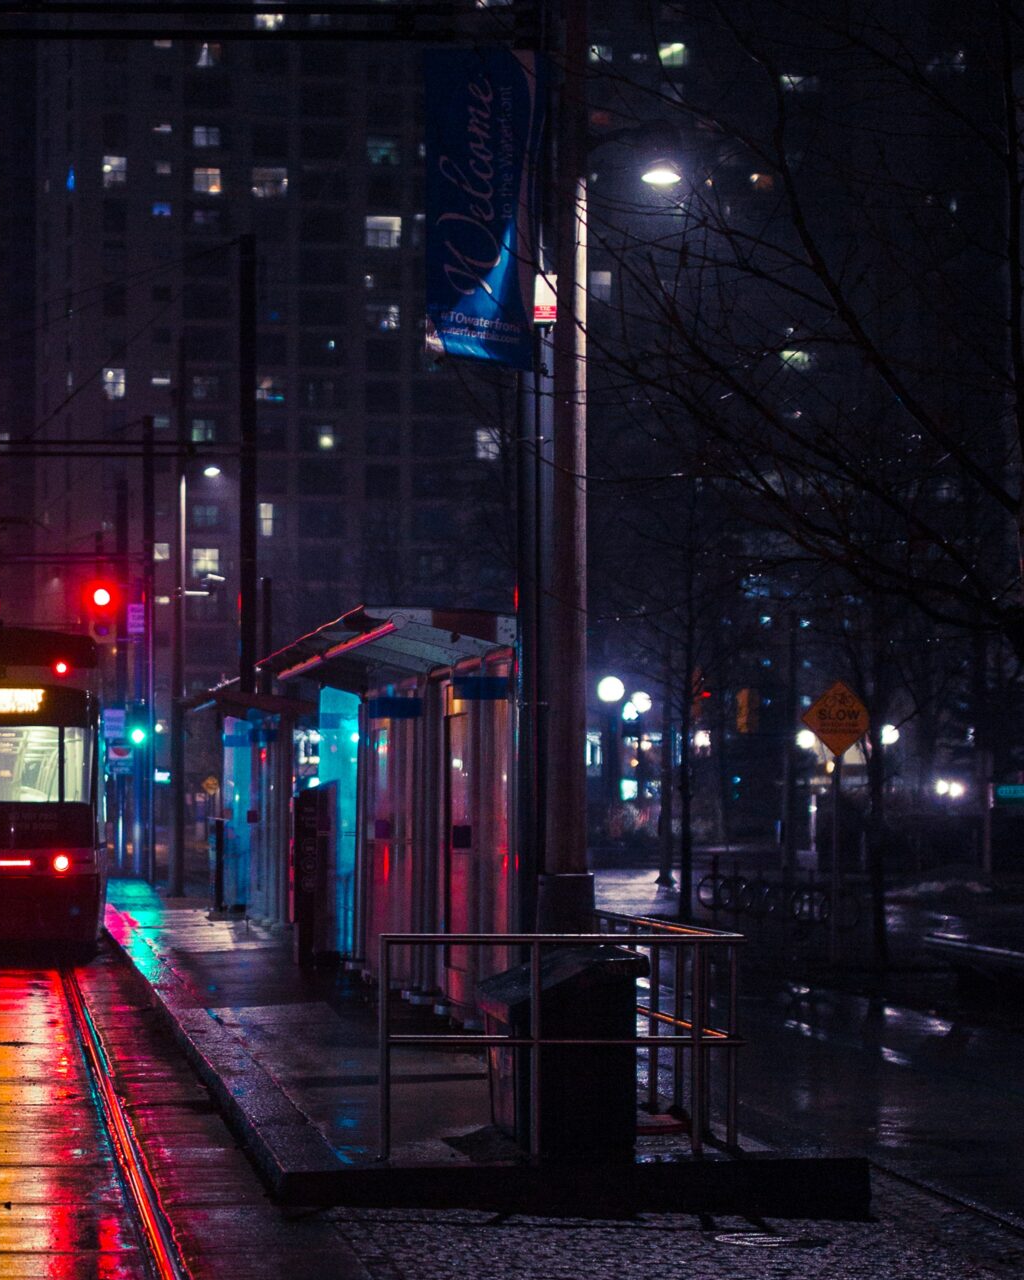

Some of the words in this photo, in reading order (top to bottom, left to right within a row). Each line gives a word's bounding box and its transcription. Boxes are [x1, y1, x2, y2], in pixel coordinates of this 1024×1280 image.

[498, 86, 513, 168] Waterfront
[435, 77, 499, 295] Welcome
[499, 171, 513, 196] the
[499, 203, 513, 219] to
[817, 708, 860, 720] SLOW
